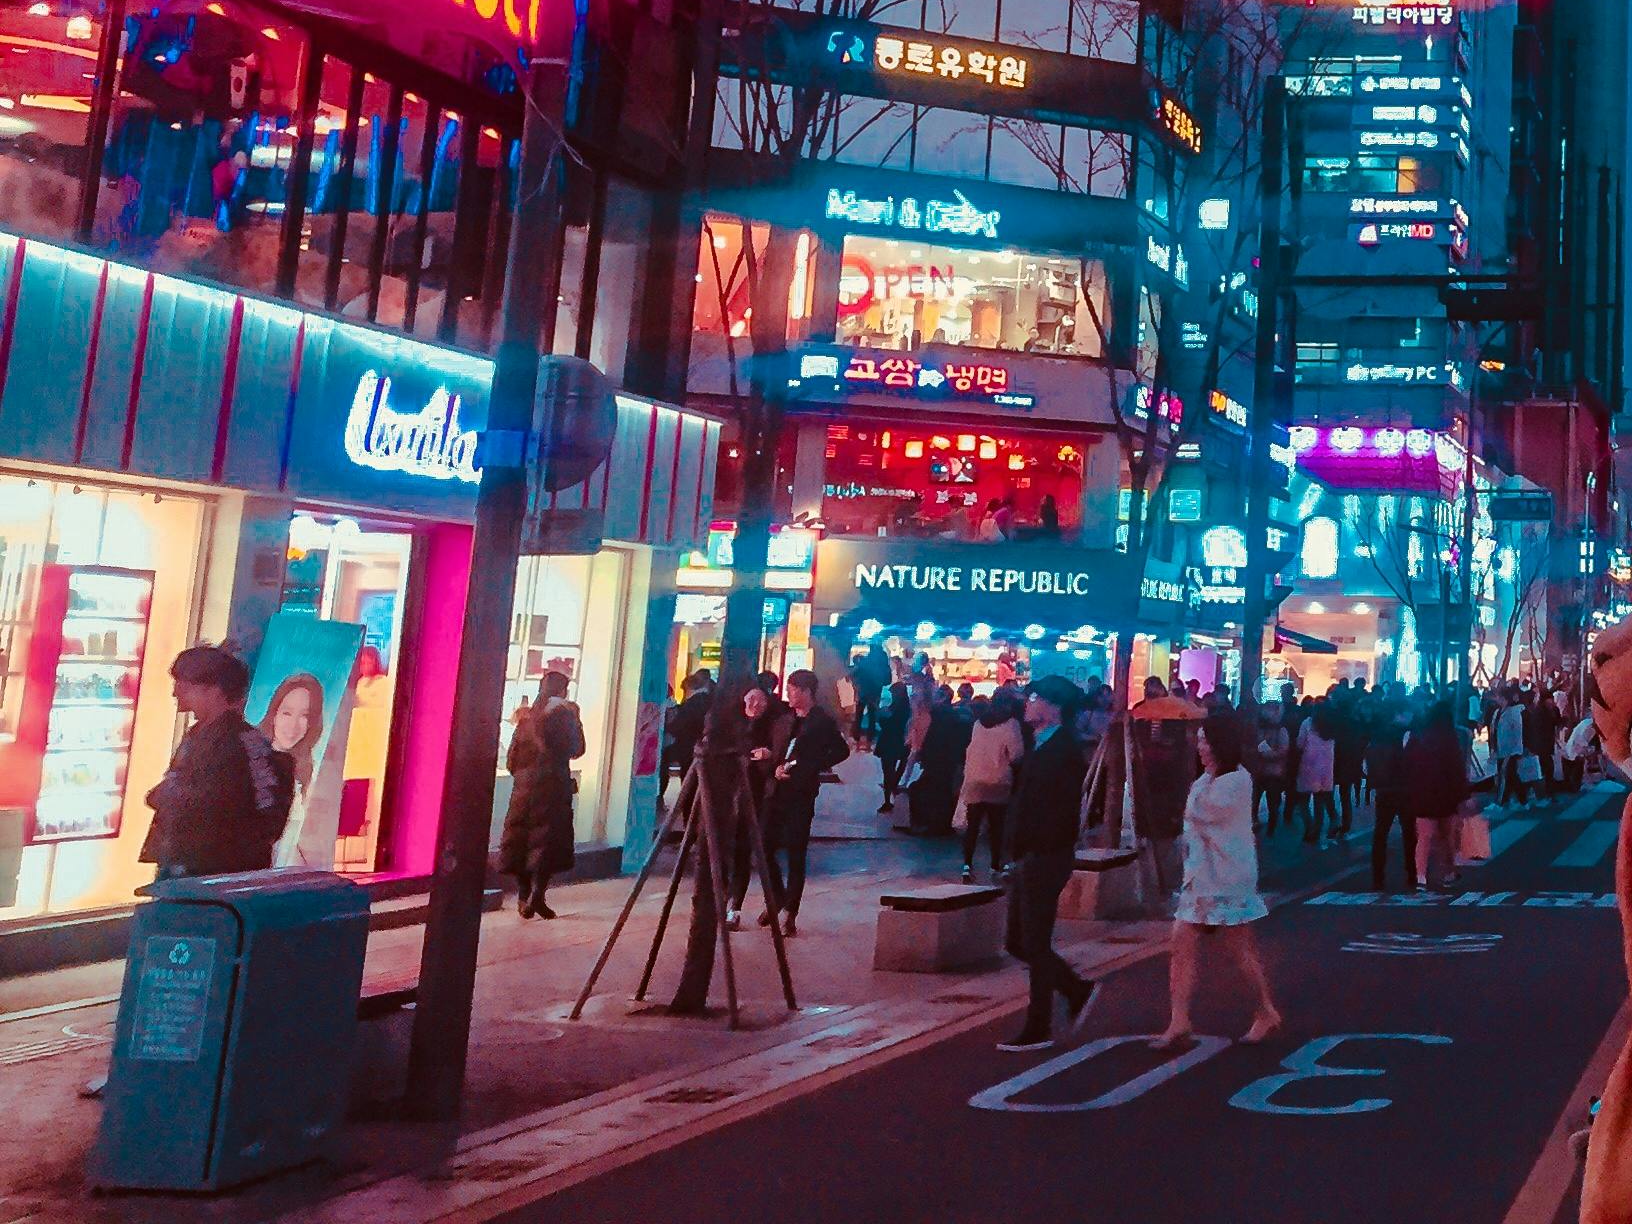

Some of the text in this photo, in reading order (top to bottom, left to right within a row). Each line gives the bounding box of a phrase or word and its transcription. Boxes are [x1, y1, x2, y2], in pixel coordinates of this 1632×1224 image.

[875, 37, 1026, 88] 종로유학원
[946, 364, 1007, 393] 냉면
[855, 563, 1089, 595] NATURE REPUBLIC
